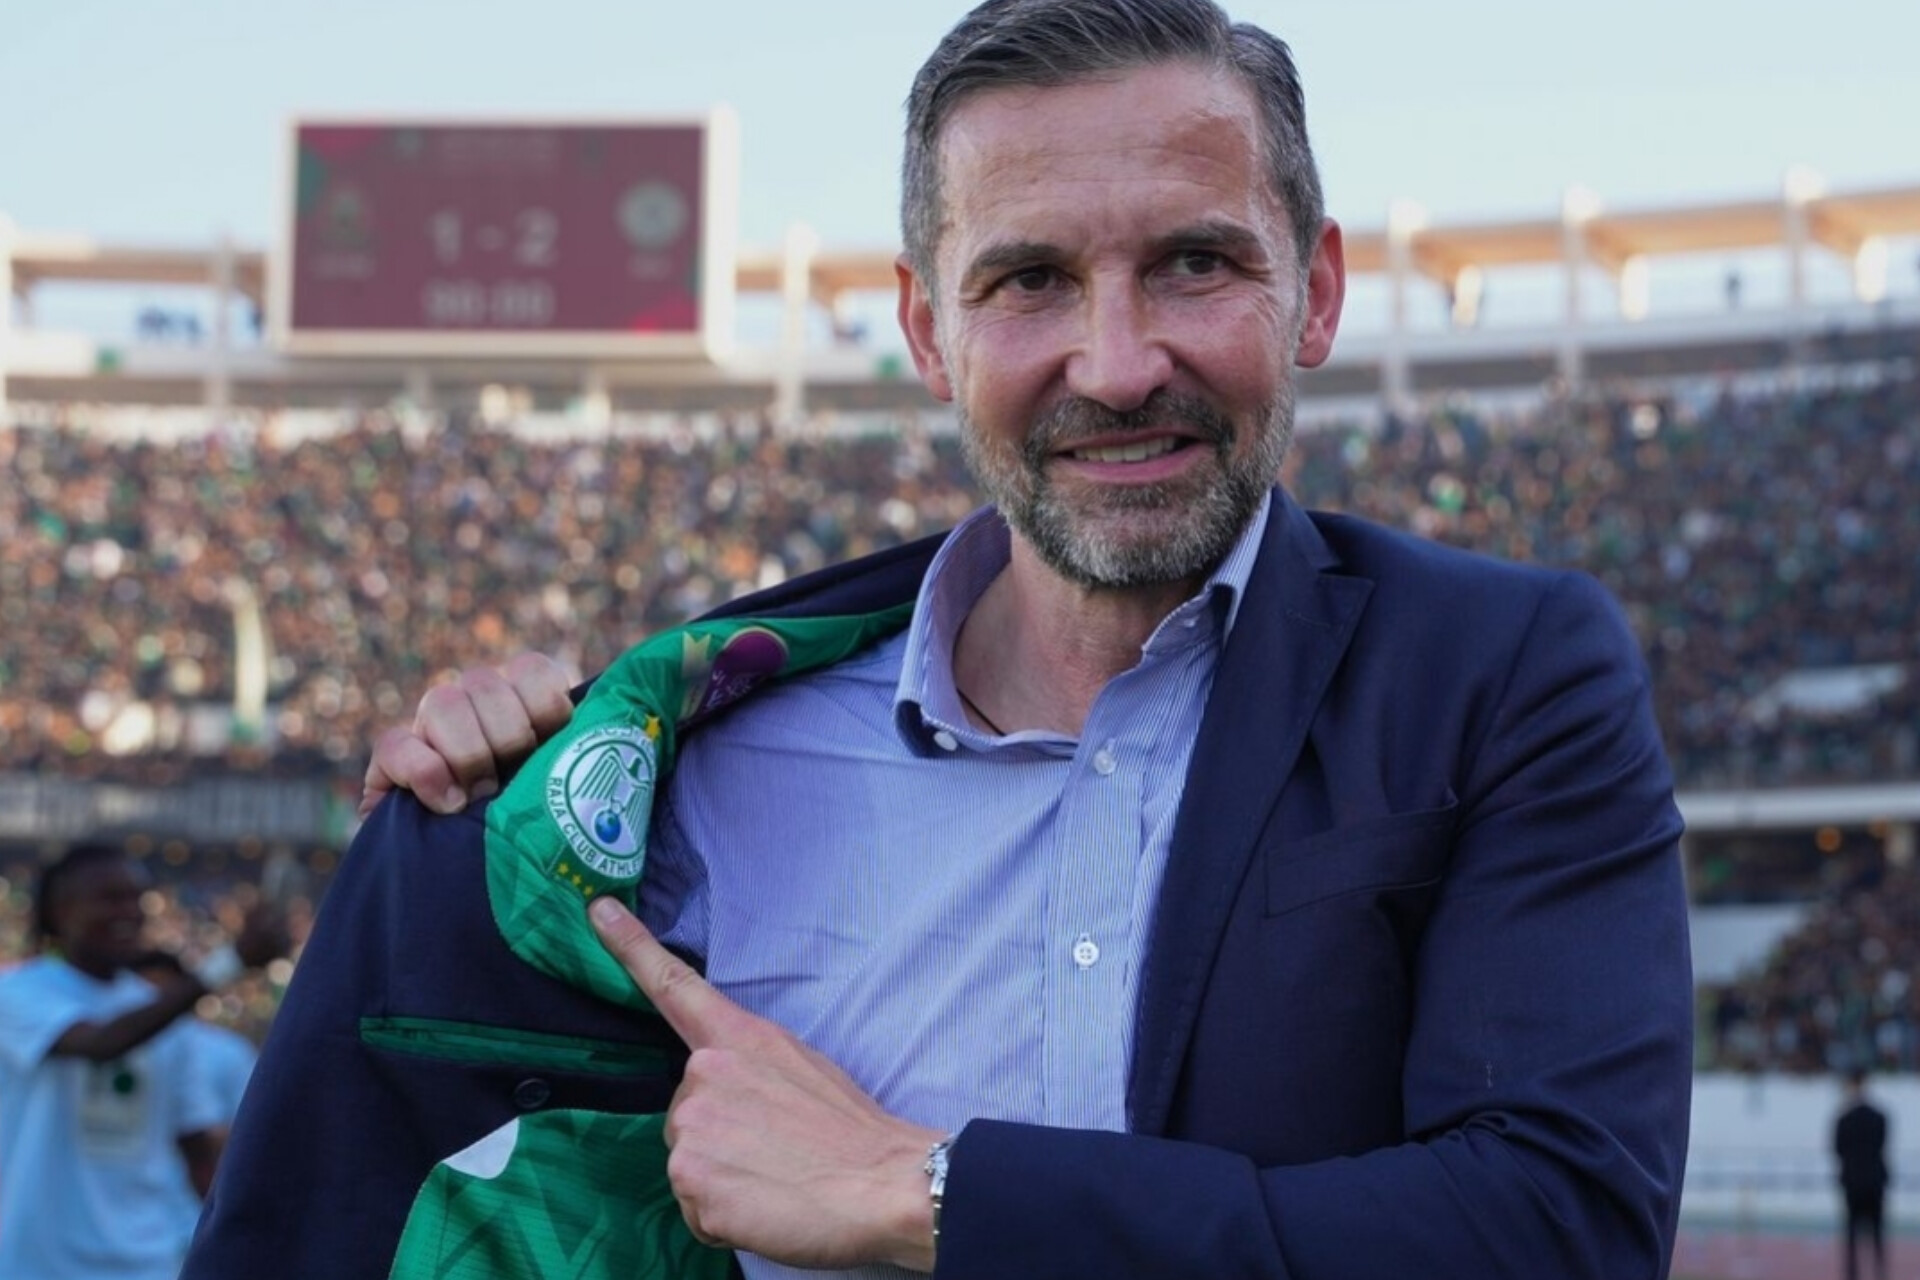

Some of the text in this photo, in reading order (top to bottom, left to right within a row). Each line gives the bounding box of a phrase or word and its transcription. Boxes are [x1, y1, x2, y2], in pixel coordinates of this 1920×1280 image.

[428, 208, 462, 266] 1
[514, 207, 558, 266] 2
[547, 776, 567, 819] RAJA
[563, 822, 597, 864] CLUB
